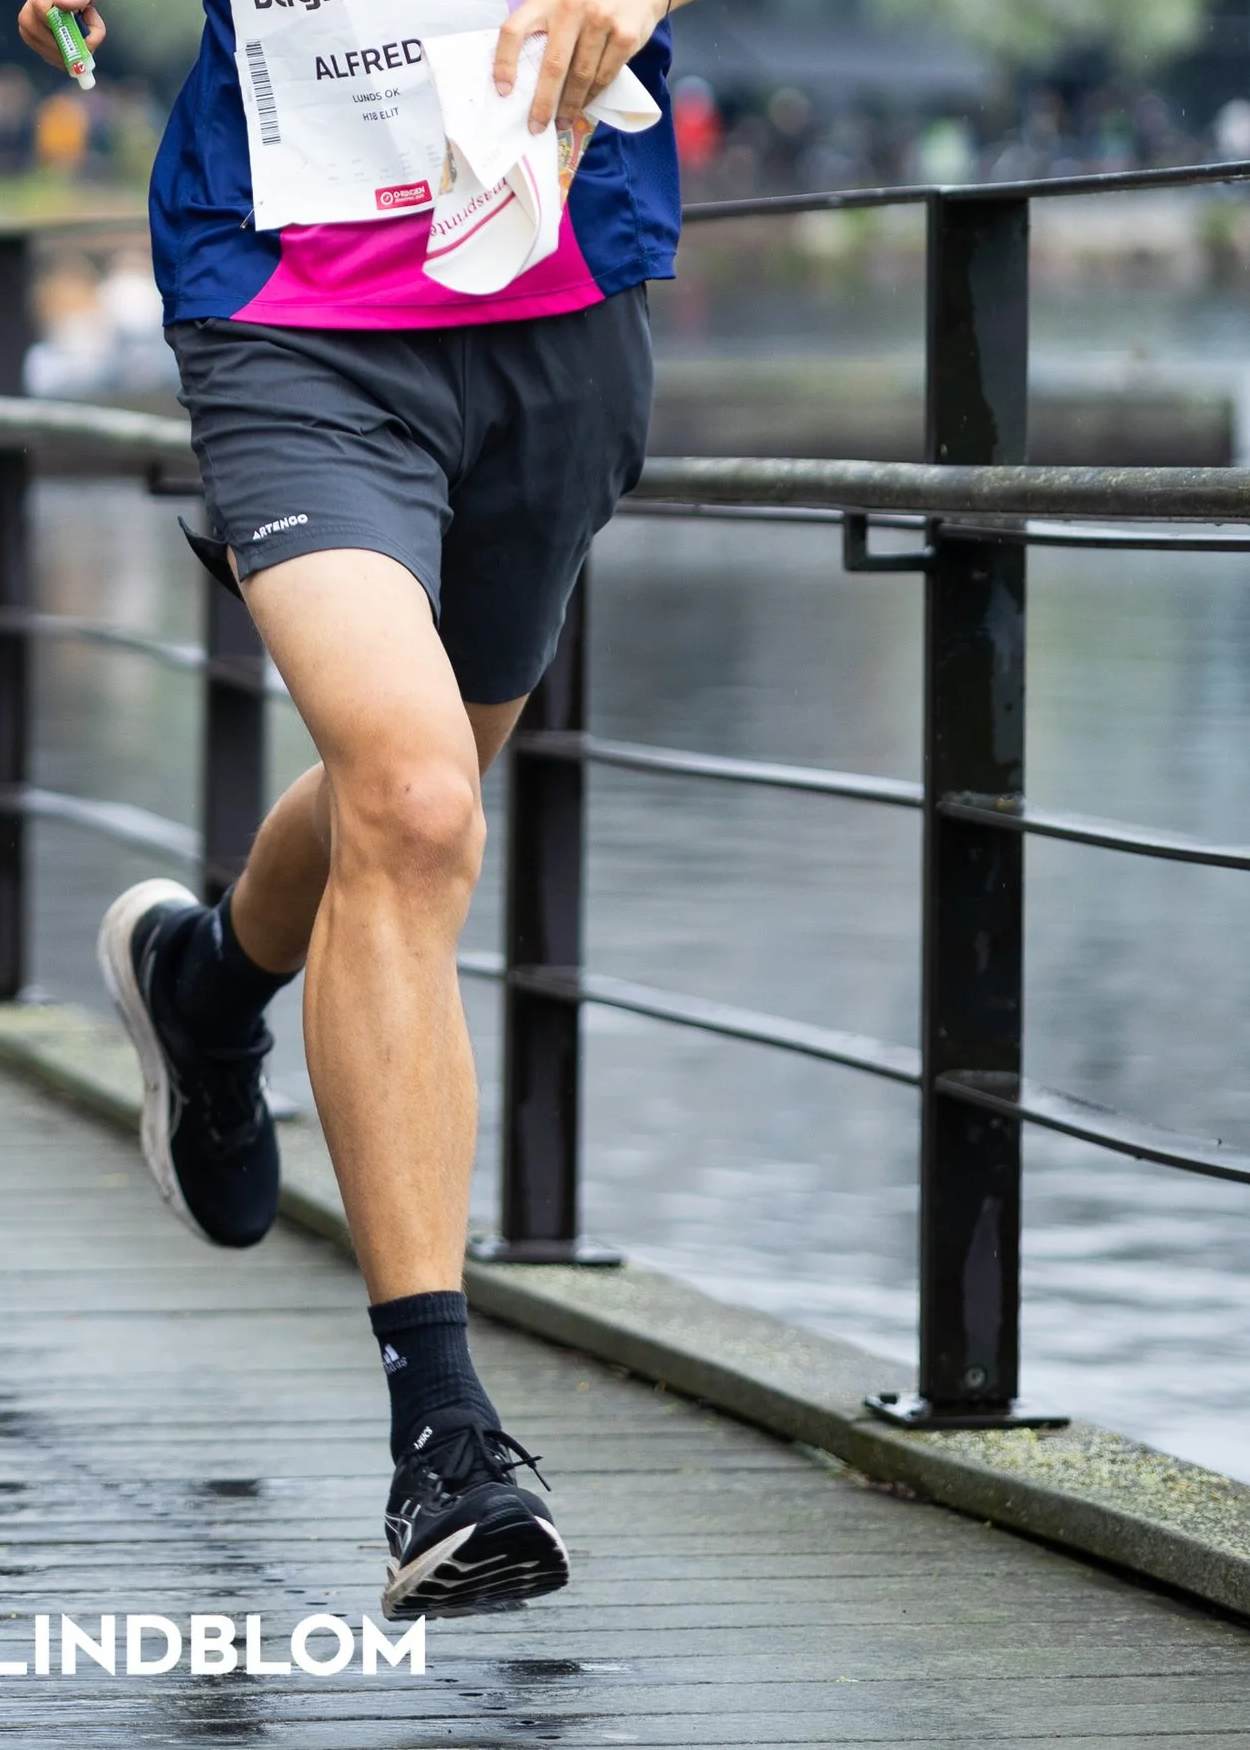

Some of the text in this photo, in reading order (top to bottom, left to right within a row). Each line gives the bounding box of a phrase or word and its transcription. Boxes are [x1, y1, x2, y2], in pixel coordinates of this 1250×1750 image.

[315, 38, 423, 81] ALFRED
[352, 87, 401, 103] LUNDS OK
[362, 107, 399, 121] H18 ELIT
[252, 513, 309, 540] ARTENGO
